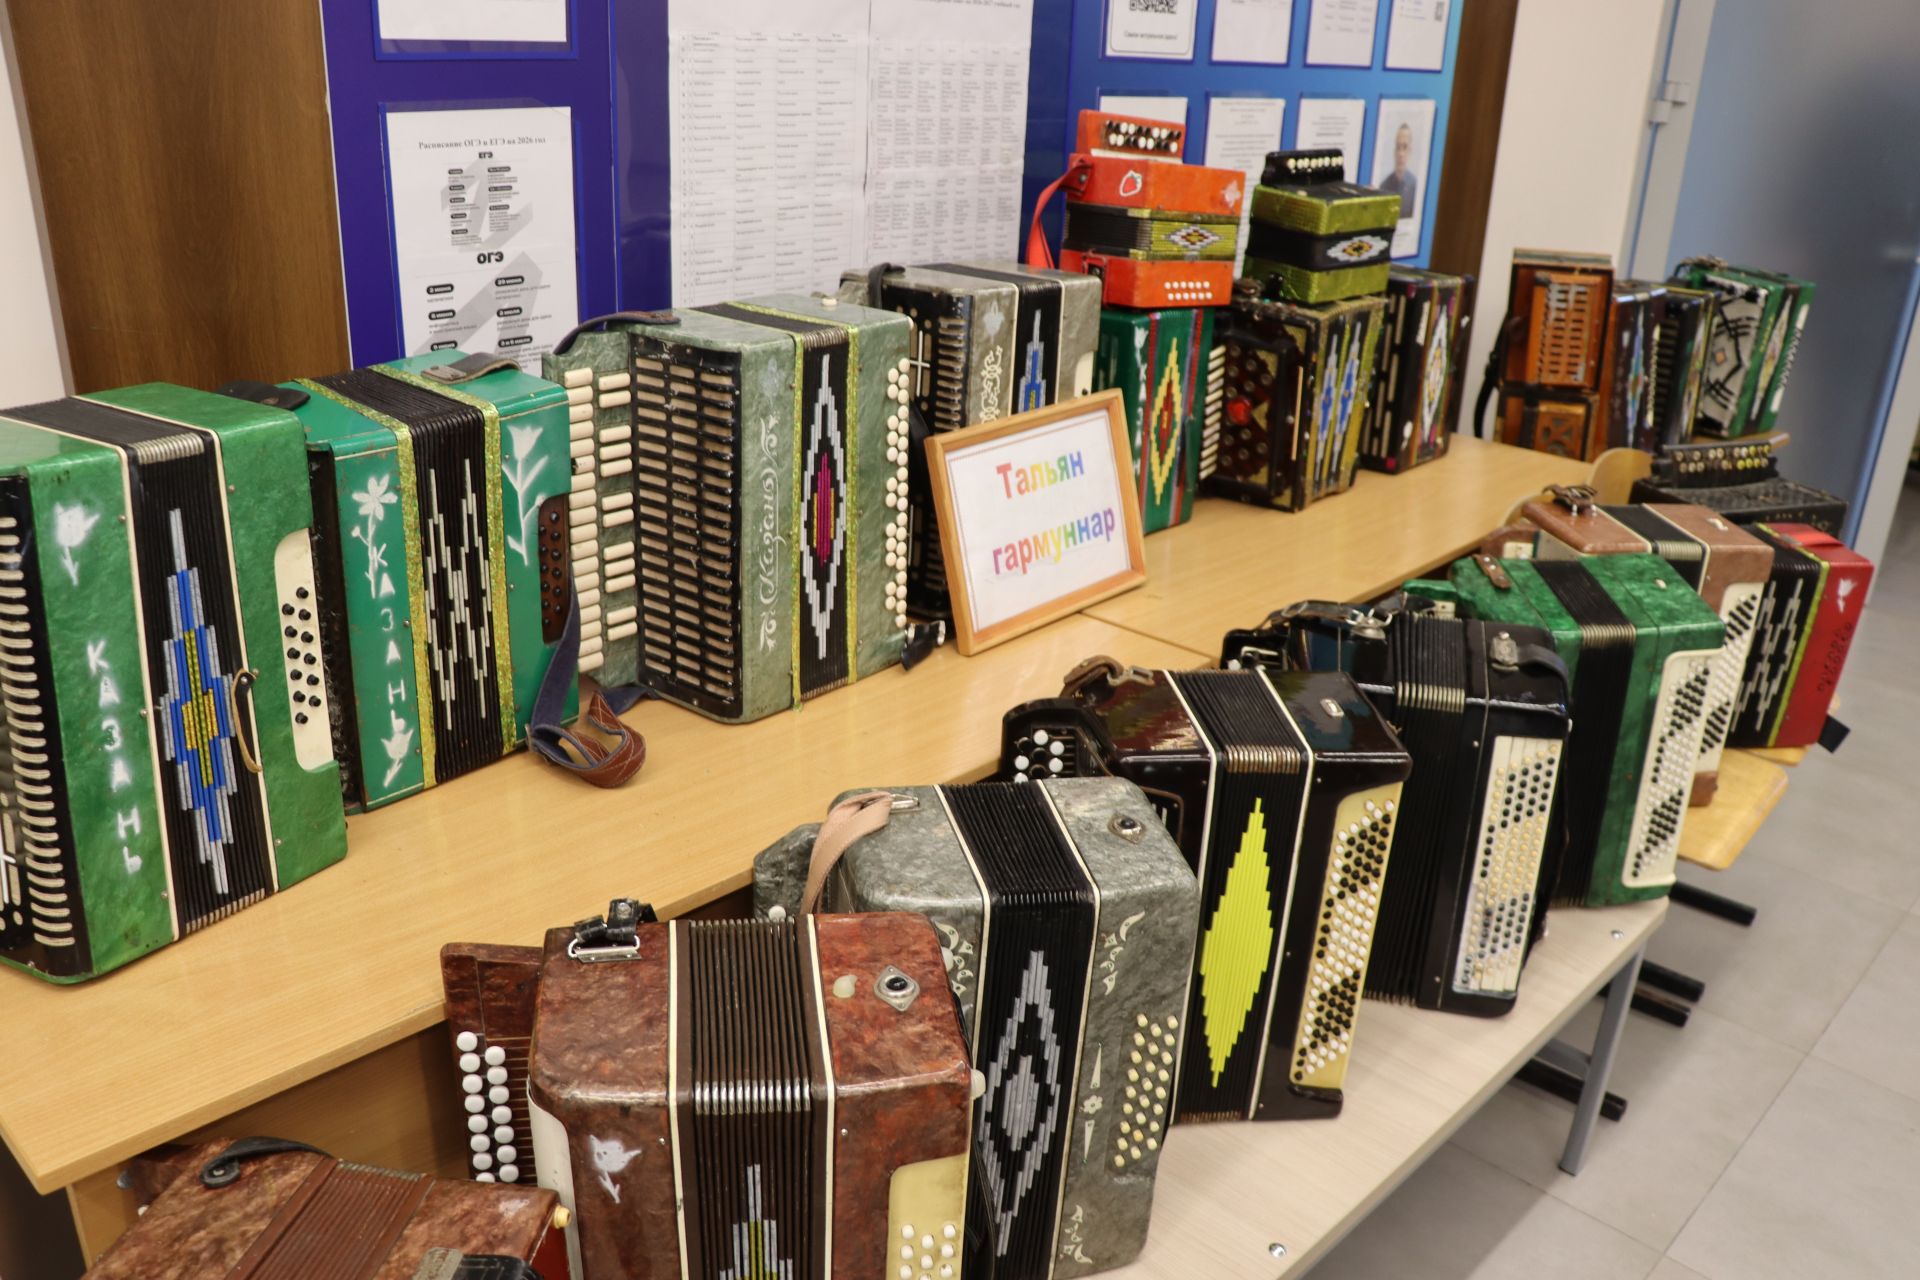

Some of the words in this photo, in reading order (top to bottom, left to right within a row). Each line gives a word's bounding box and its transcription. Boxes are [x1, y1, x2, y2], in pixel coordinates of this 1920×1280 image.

[418, 140, 461, 149] Расписание
[464, 138, 481, 147] ОГЭ
[489, 138, 506, 146] ЕГЭ
[517, 136, 533, 144] 2026
[478, 151, 493, 159] ЕГЭ
[477, 251, 504, 265] ОГЭ
[996, 449, 1085, 500] Тальян
[992, 506, 1116, 576] гармуннар
[372, 544, 409, 733] КАЗАНЬ
[86, 639, 143, 875] КАЗАНЬ
